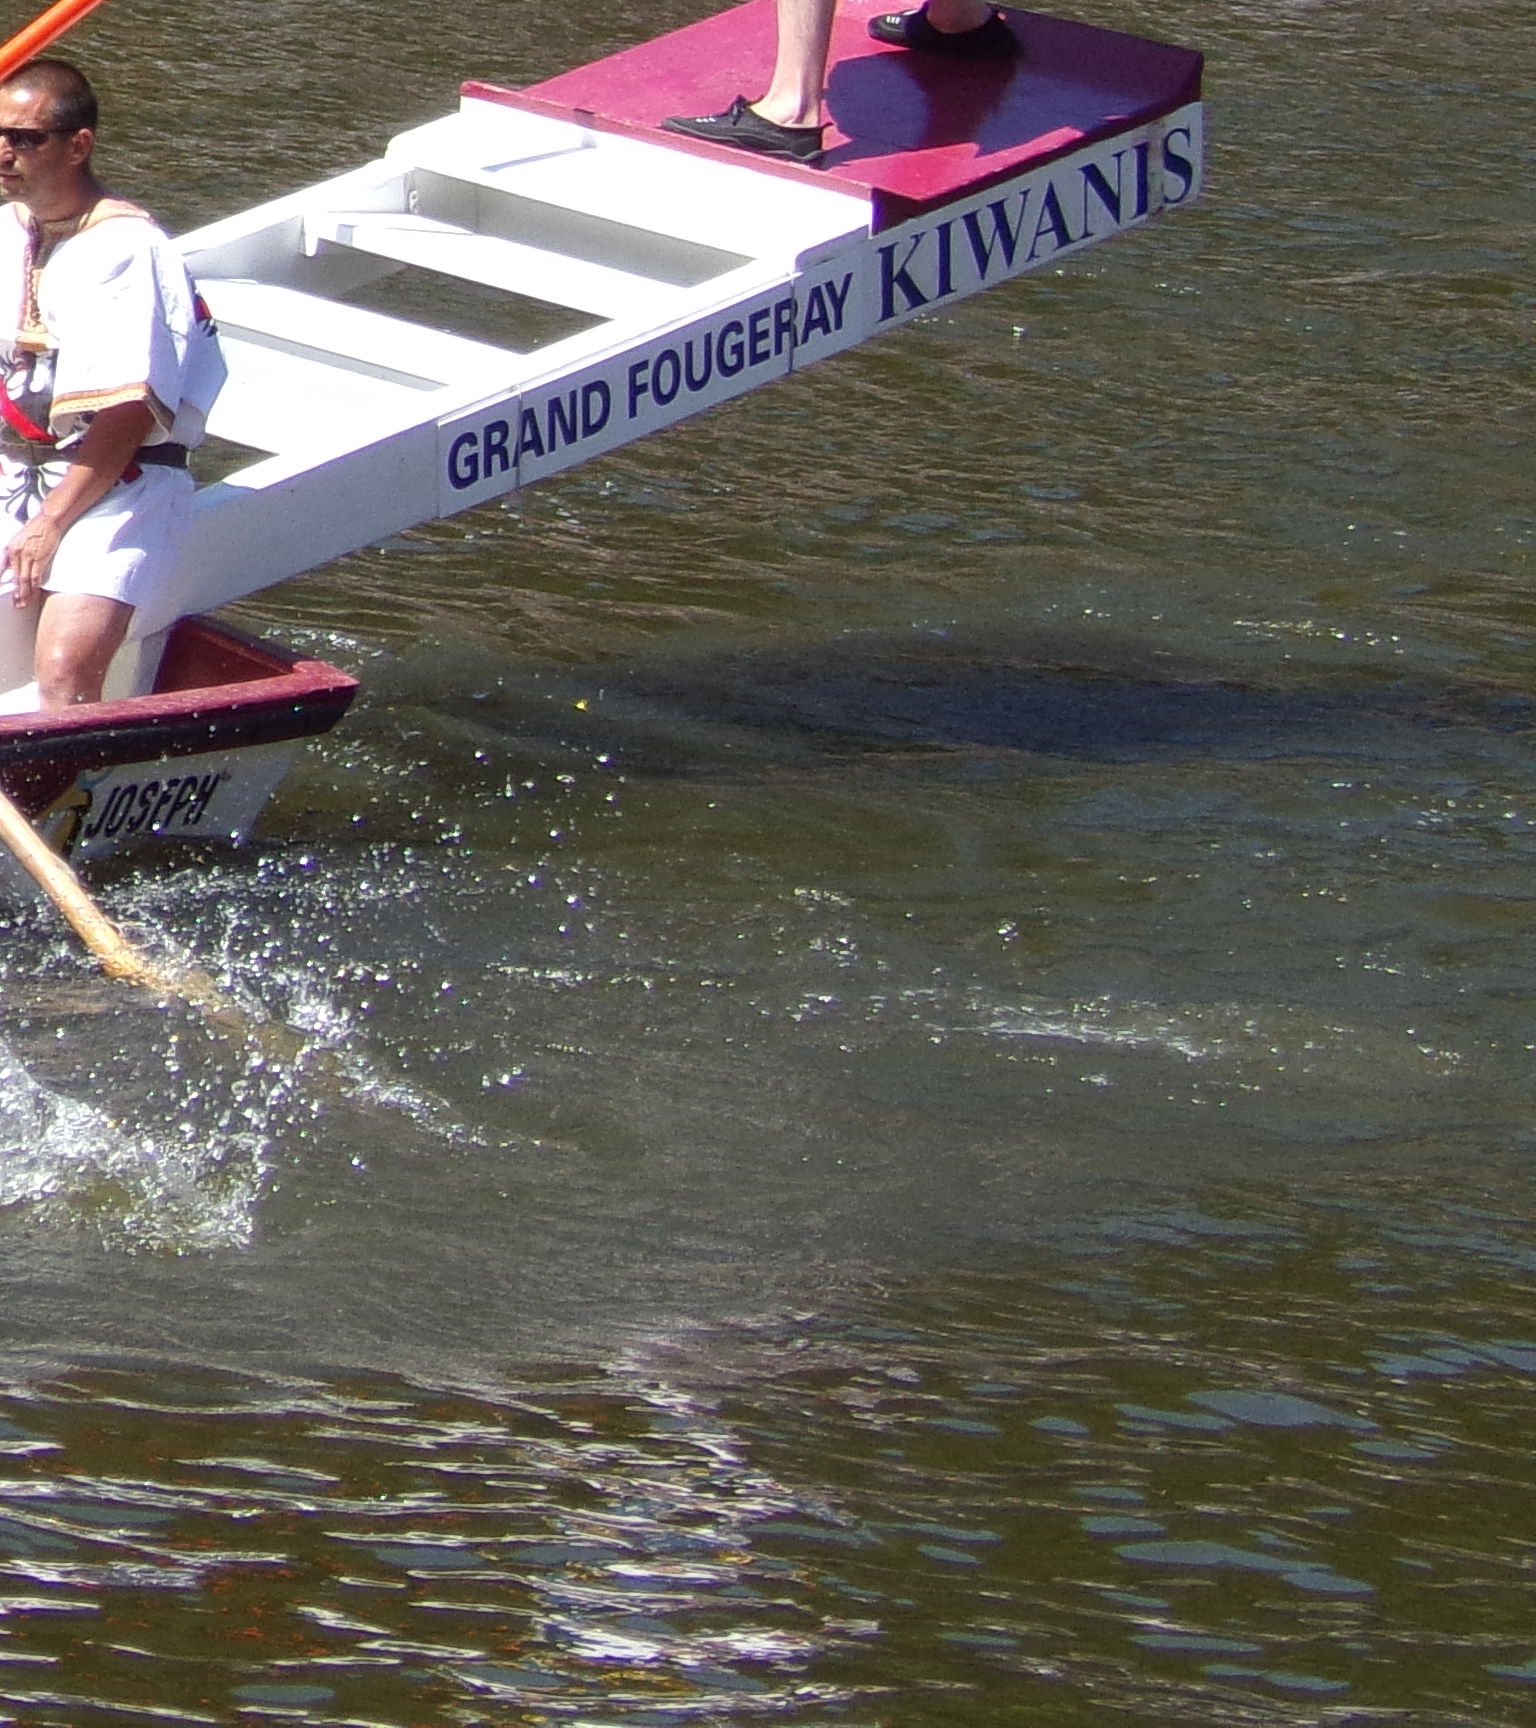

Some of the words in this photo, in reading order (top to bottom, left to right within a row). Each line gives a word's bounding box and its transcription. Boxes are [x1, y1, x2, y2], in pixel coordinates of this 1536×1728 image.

[876, 126, 1194, 323] KIWANIS
[447, 378, 611, 491] GRAND
[628, 273, 854, 420] FOUGERAY
[85, 774, 221, 838] JOSEPH
